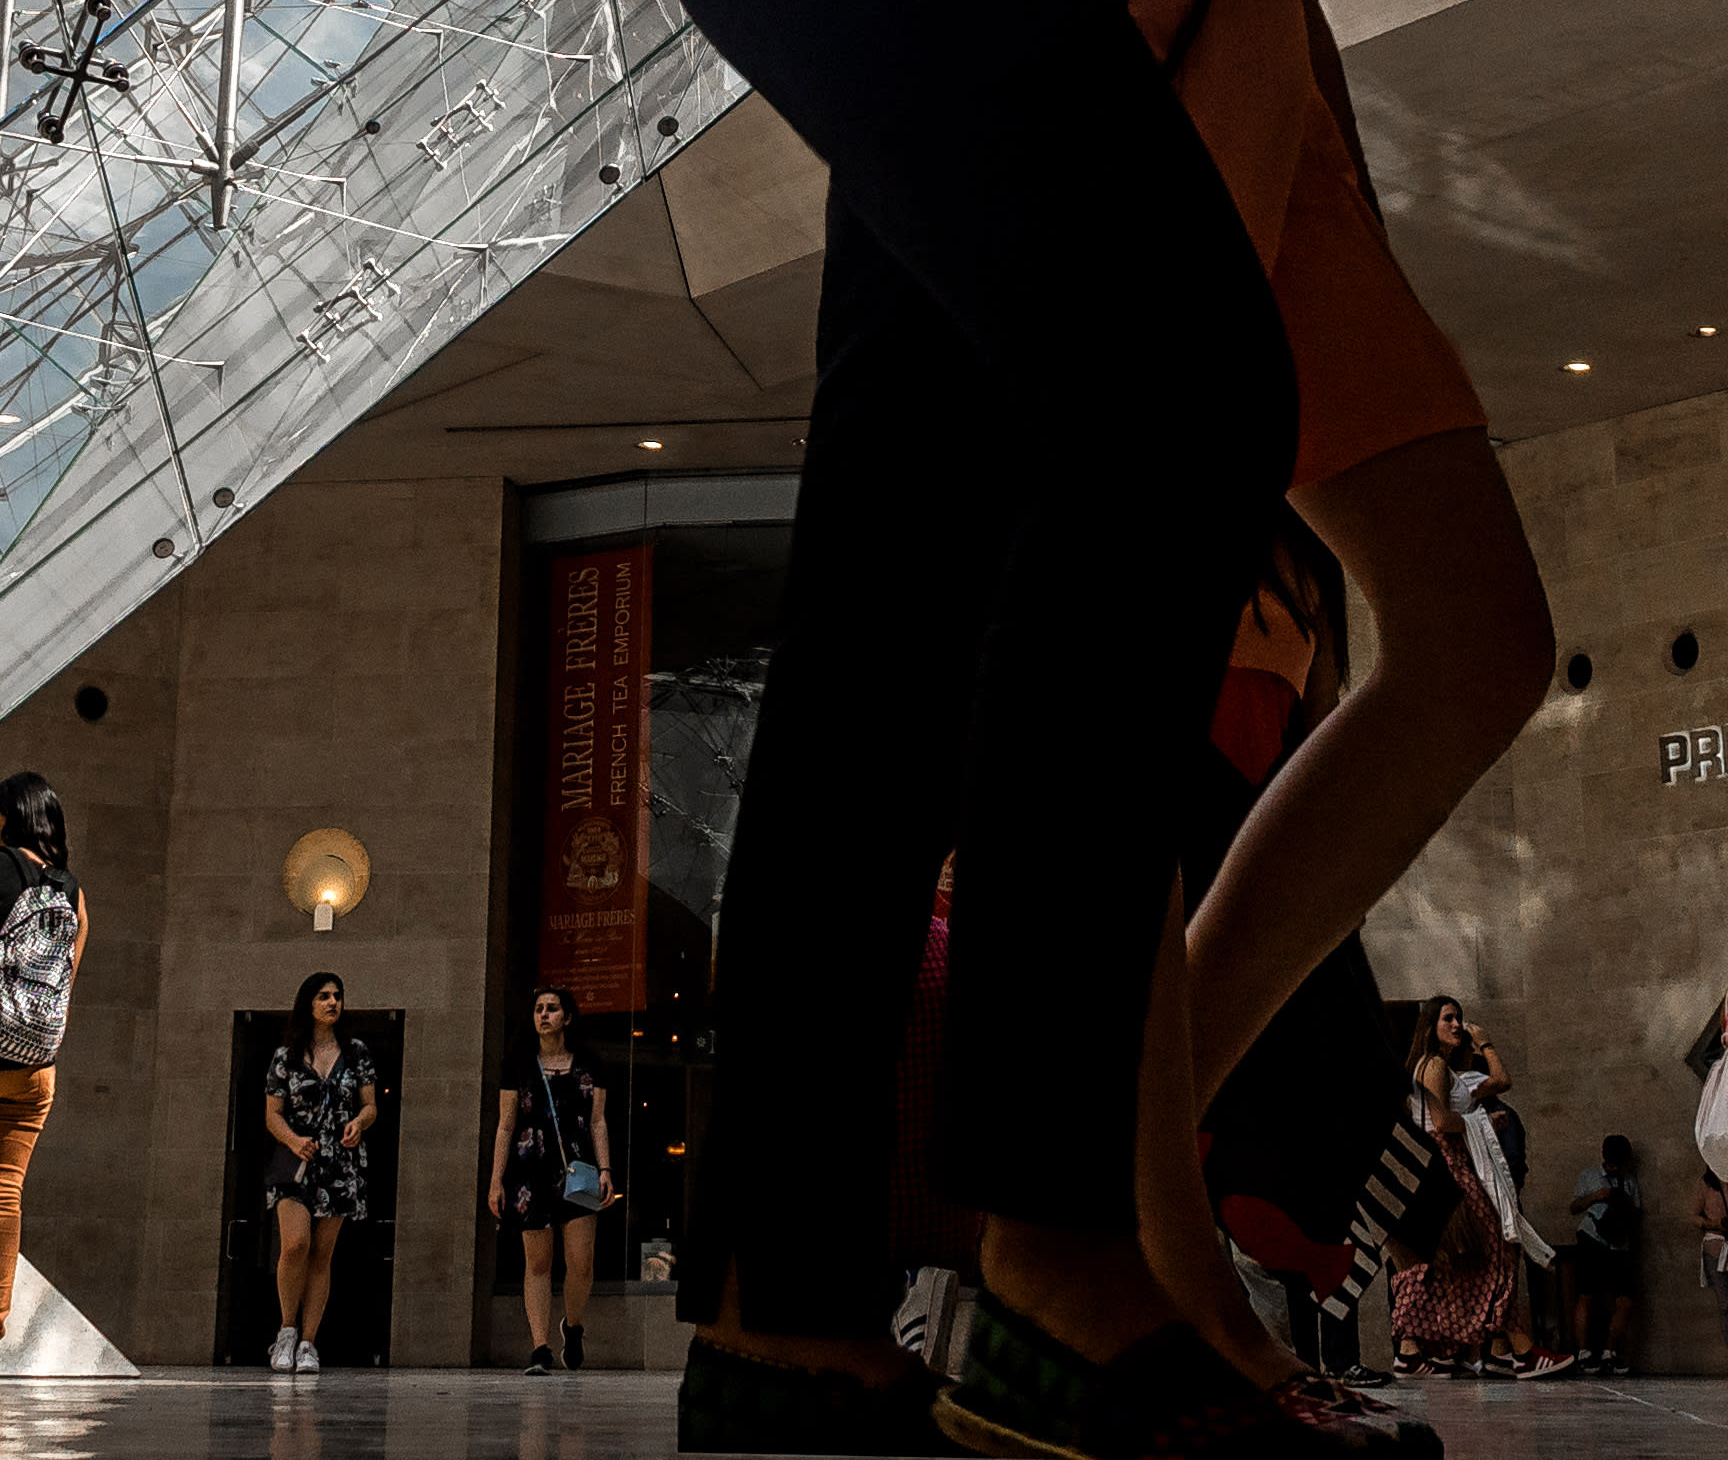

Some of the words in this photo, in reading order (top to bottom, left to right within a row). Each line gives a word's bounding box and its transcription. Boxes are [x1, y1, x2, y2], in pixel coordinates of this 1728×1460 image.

[557, 566, 600, 673] FRÈRES
[613, 562, 633, 667] EMPORIUM
[560, 681, 596, 813] MARIAGE
[611, 675, 630, 716] TEA
[610, 723, 628, 807] FRENCH
